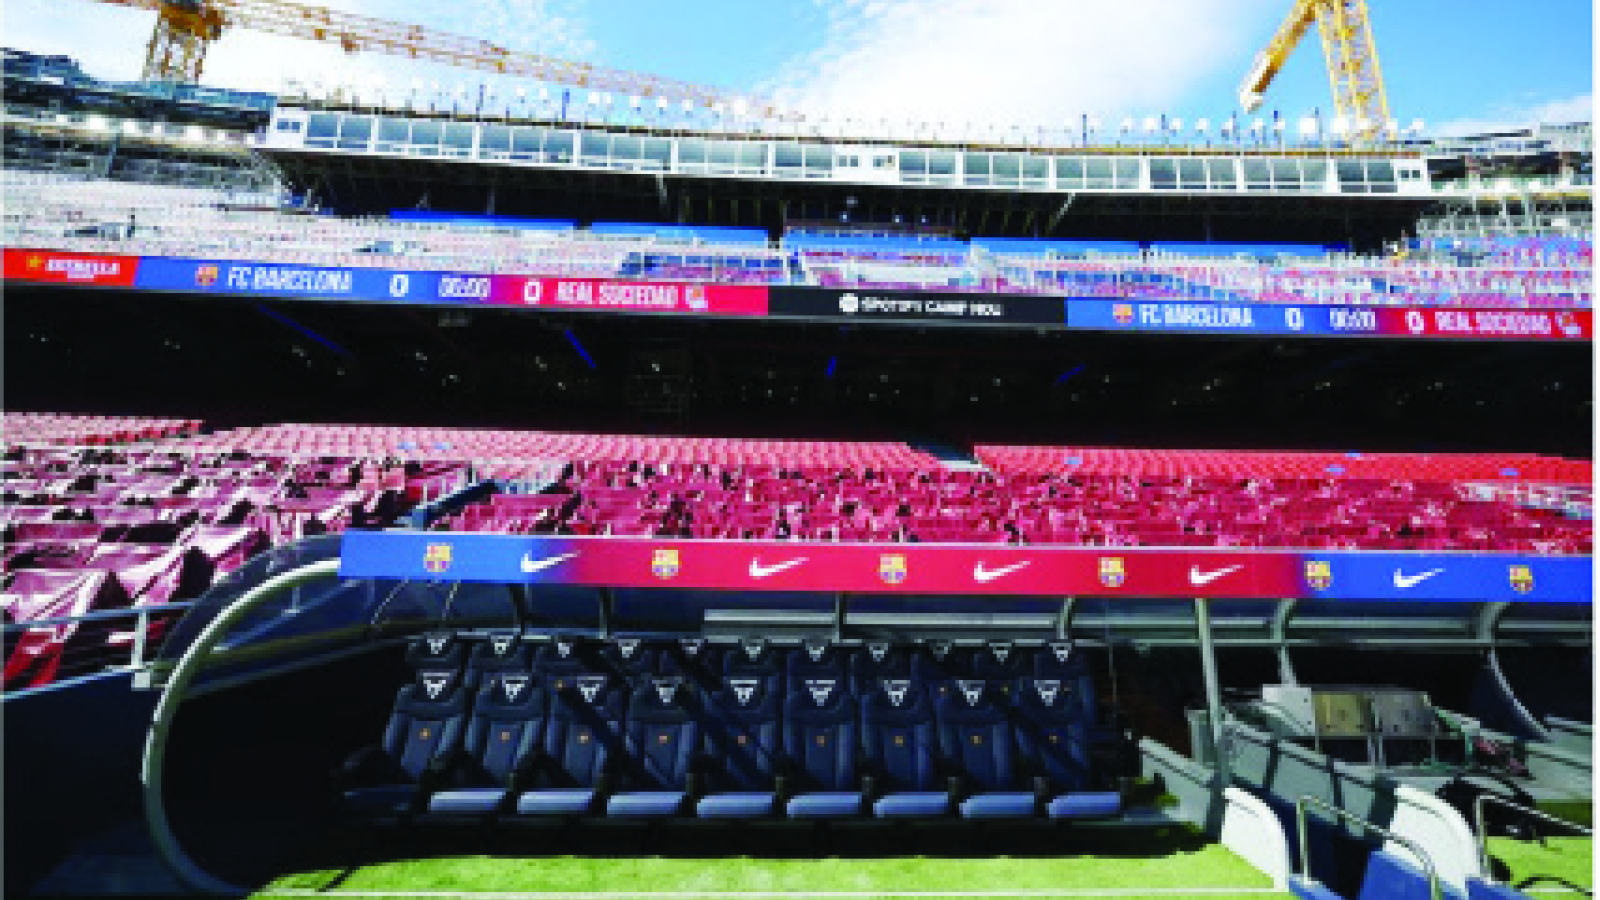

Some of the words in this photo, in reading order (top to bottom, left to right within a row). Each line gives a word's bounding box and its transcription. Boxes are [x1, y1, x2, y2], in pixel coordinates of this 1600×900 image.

[229, 266, 251, 287] FC
[254, 267, 352, 291] BARCELONA
[389, 273, 409, 297] 0
[523, 280, 543, 304] 0
[556, 281, 593, 305] REAL
[599, 283, 678, 309] SOCIEDAD
[862, 296, 923, 313] SPOTIFY
[1139, 303, 1162, 324] FC
[1165, 304, 1253, 327] BARCELONA
[1285, 307, 1304, 330] 0
[1405, 309, 1424, 331] 0
[1435, 311, 1471, 332] REAL
[1474, 312, 1551, 335] SOCIEDAD
